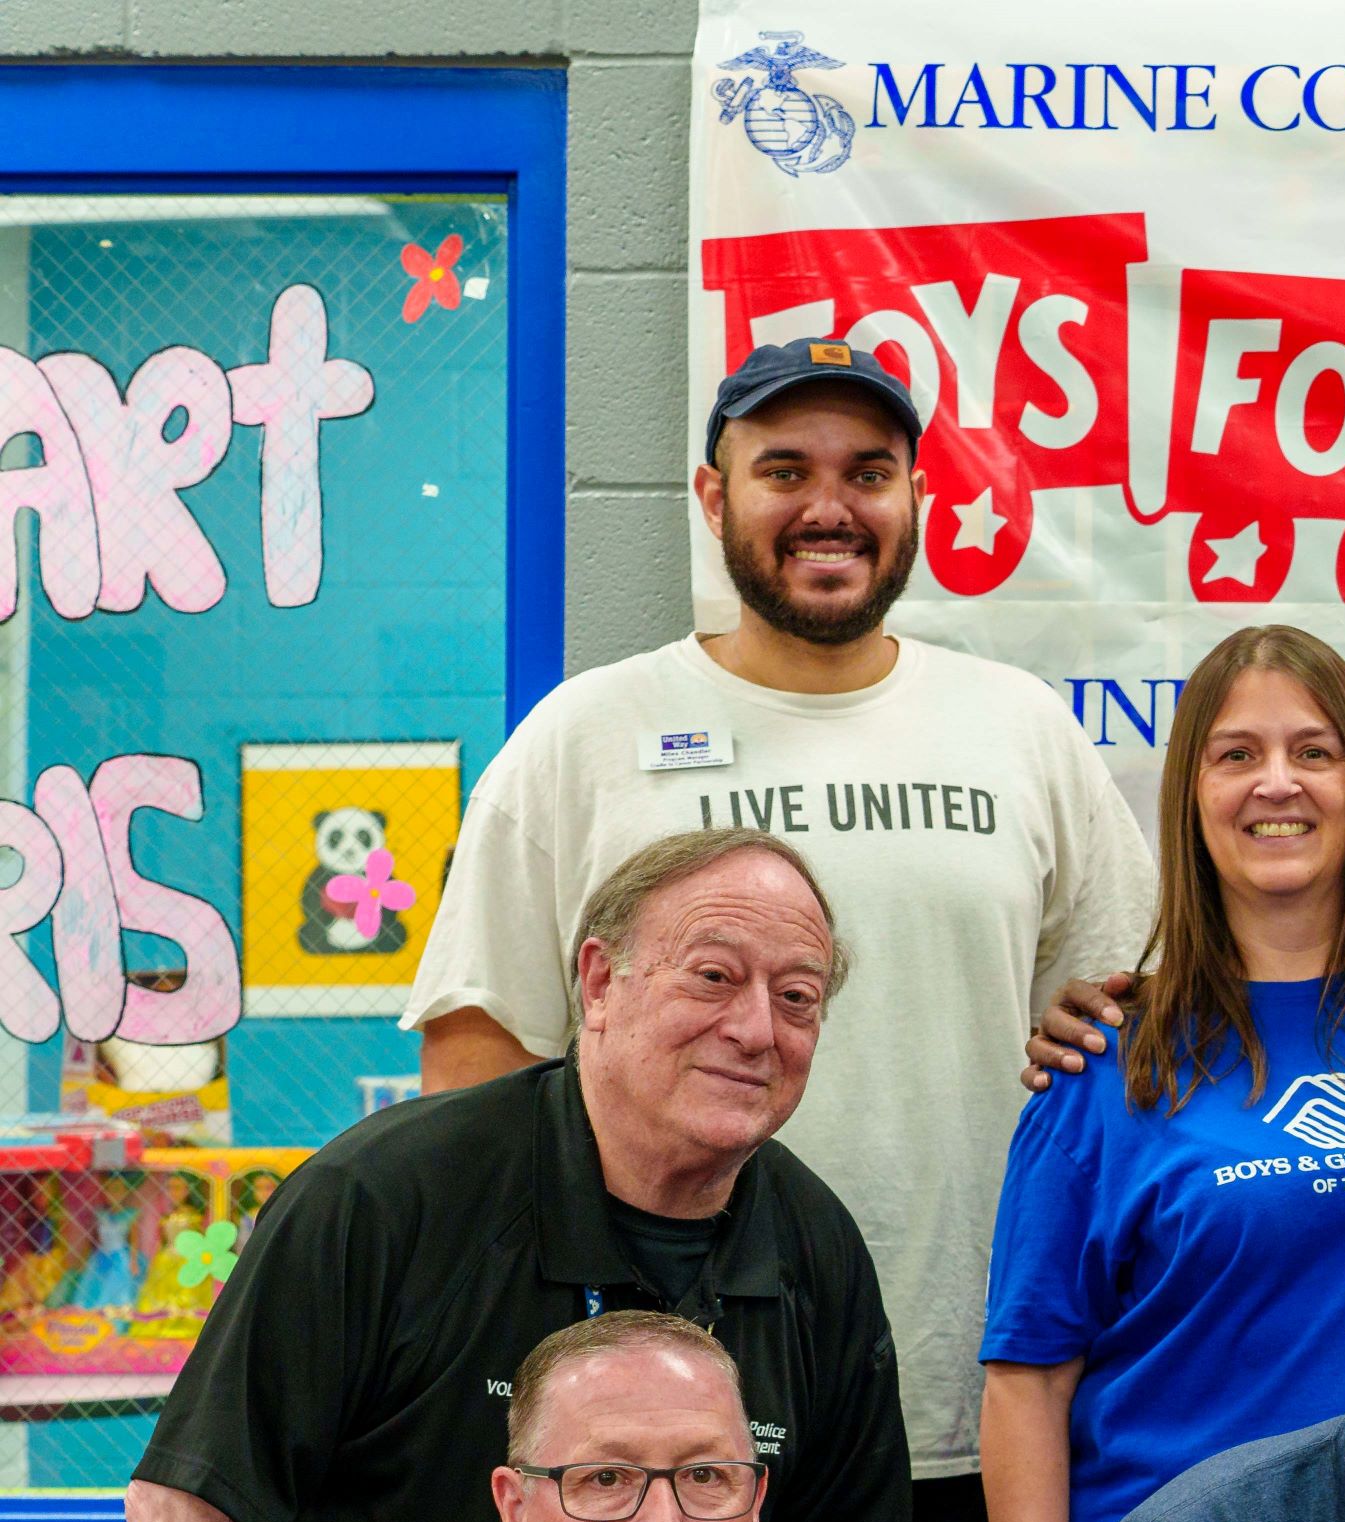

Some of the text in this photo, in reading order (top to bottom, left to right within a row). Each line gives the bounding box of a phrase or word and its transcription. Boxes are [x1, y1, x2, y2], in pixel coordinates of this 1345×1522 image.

[868, 63, 1216, 132] MARINE
[662, 735, 688, 743] United
[700, 783, 997, 835] LIVE UNITED
[1213, 1157, 1292, 1186] BOYS
[1298, 1155, 1320, 1172] &
[1312, 1178, 1338, 1193] OF
[749, 1421, 787, 1439] Police
